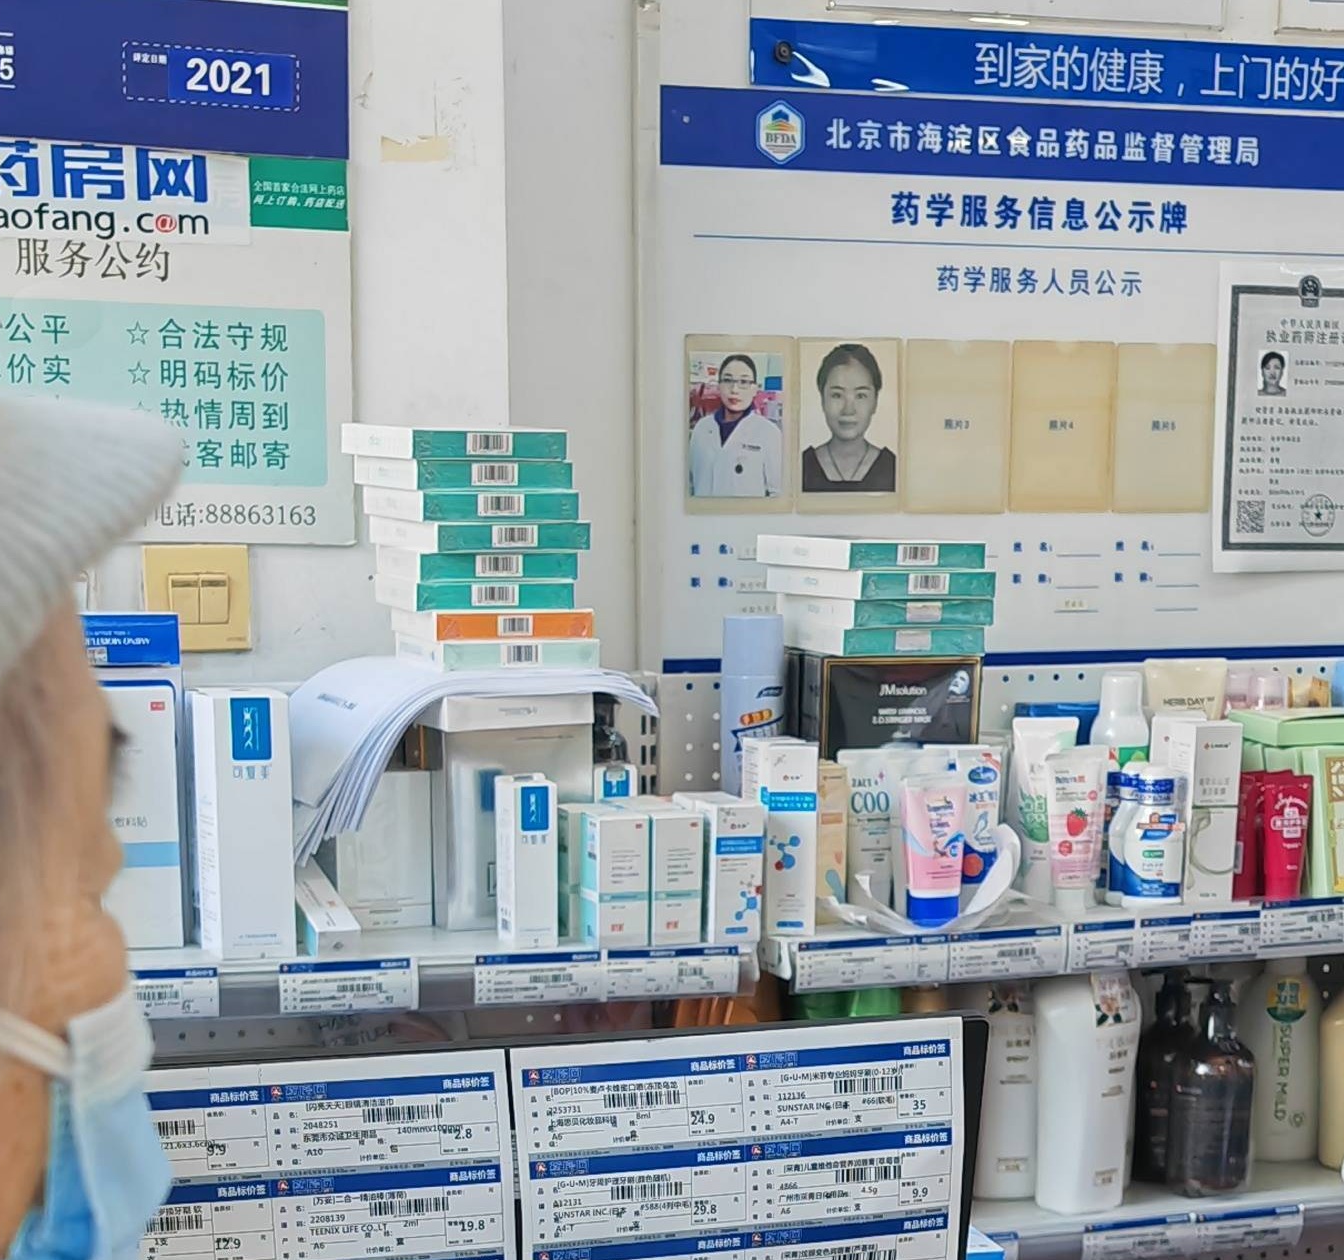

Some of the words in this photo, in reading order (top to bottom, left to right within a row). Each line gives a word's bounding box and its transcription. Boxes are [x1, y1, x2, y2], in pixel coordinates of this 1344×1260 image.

[185, 57, 271, 96] 2021
[763, 131, 798, 147] BFDA
[824, 119, 1261, 167] 北京市海淀区食品药品监督管理局
[890, 192, 1189, 235] 药学服务信息公示牌
[15, 238, 171, 283] 服务公约
[936, 265, 1144, 297] 药学服务人员公示
[157, 320, 289, 352] 合法守规
[158, 360, 289, 392] 明码标价
[160, 400, 289, 432] 热情周到
[182, 439, 290, 471] 客邮寄
[144, 500, 317, 529] 电话:88863163
[441, 1075, 490, 1090] 商品标价签
[209, 1090, 259, 1103] 商品标价签
[912, 1099, 927, 1111] 35
[302, 1120, 339, 1131] 2048251
[903, 1132, 948, 1145] 商品标价签
[306, 1148, 324, 1157] A10
[696, 1150, 741, 1163] 商品标价签
[860, 1186, 878, 1196] 4.5g
[912, 1187, 929, 1199] 9.9
[309, 1214, 346, 1224] 2208139
[402, 1218, 420, 1228] 2ml
[310, 1226, 340, 1237] TEENIX
